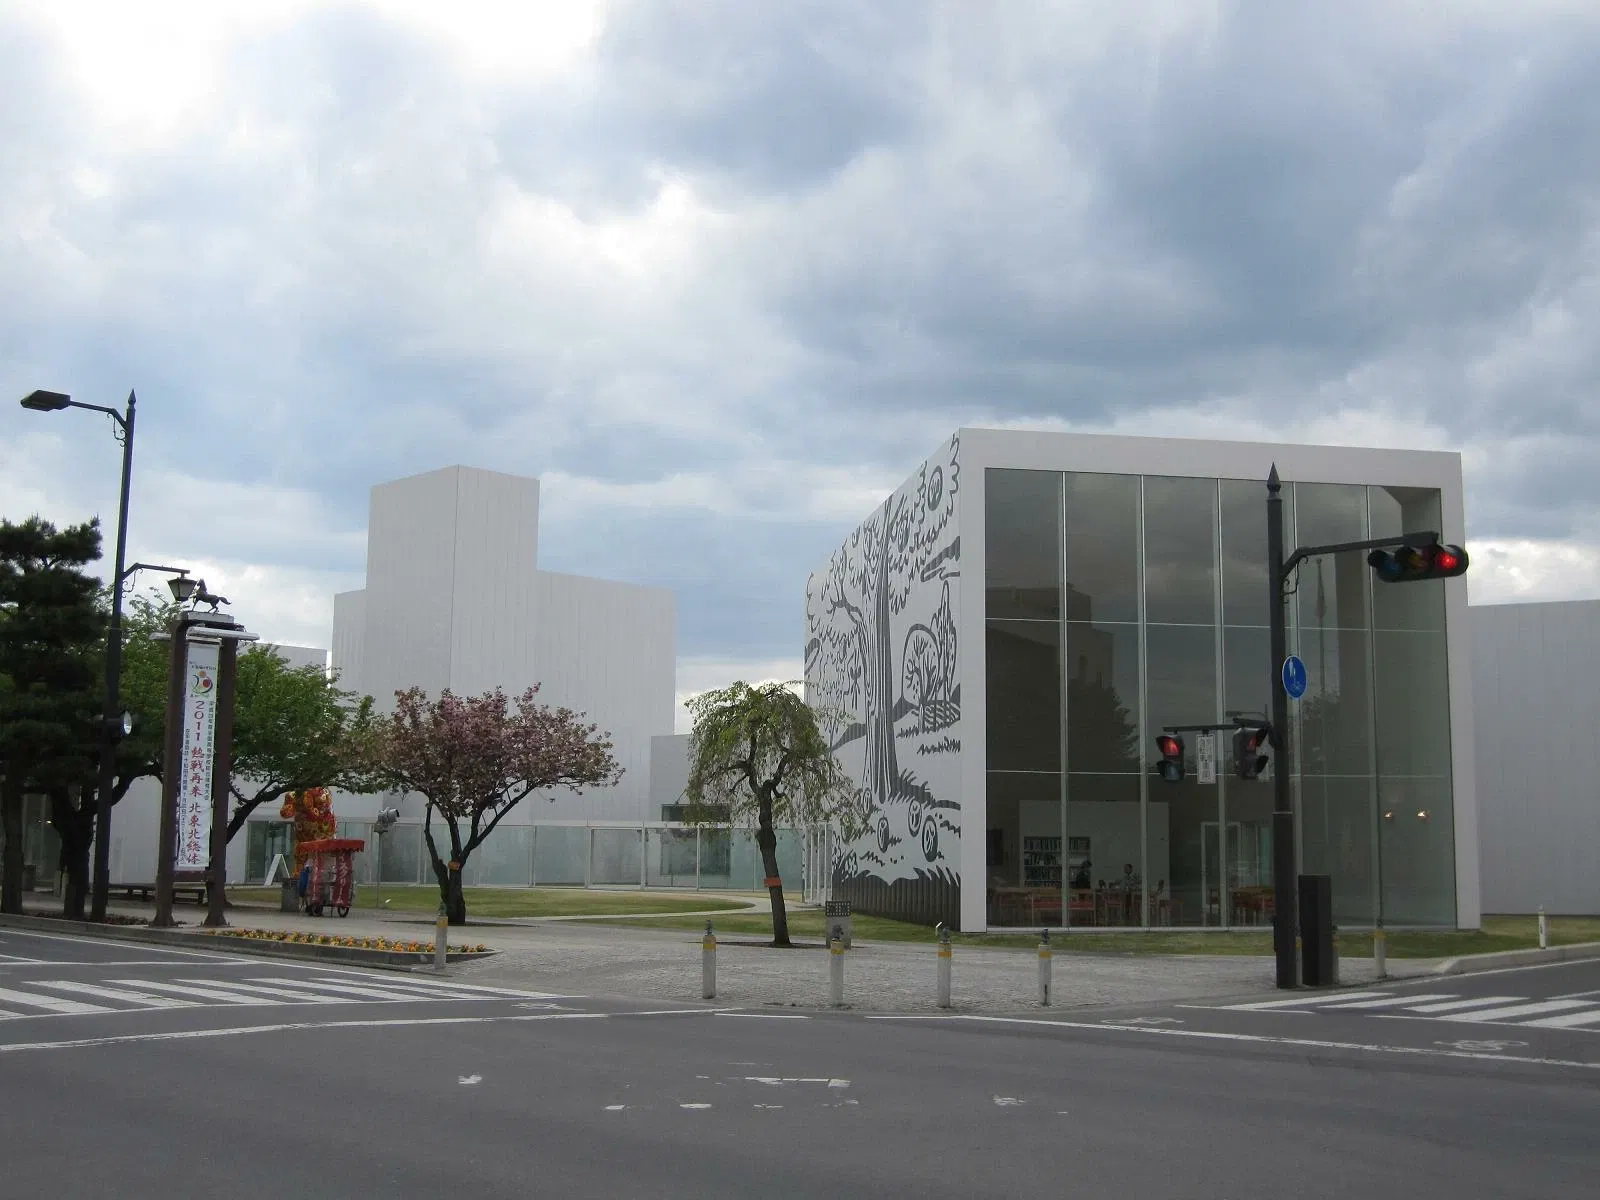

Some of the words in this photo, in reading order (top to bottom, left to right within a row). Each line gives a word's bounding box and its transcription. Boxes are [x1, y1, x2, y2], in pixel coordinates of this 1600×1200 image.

[194, 700, 205, 741] 2011
[190, 746, 205, 798] 熱戦再来
[186, 802, 202, 865] 北東北総体
[336, 849, 348, 904] イスクリーム
